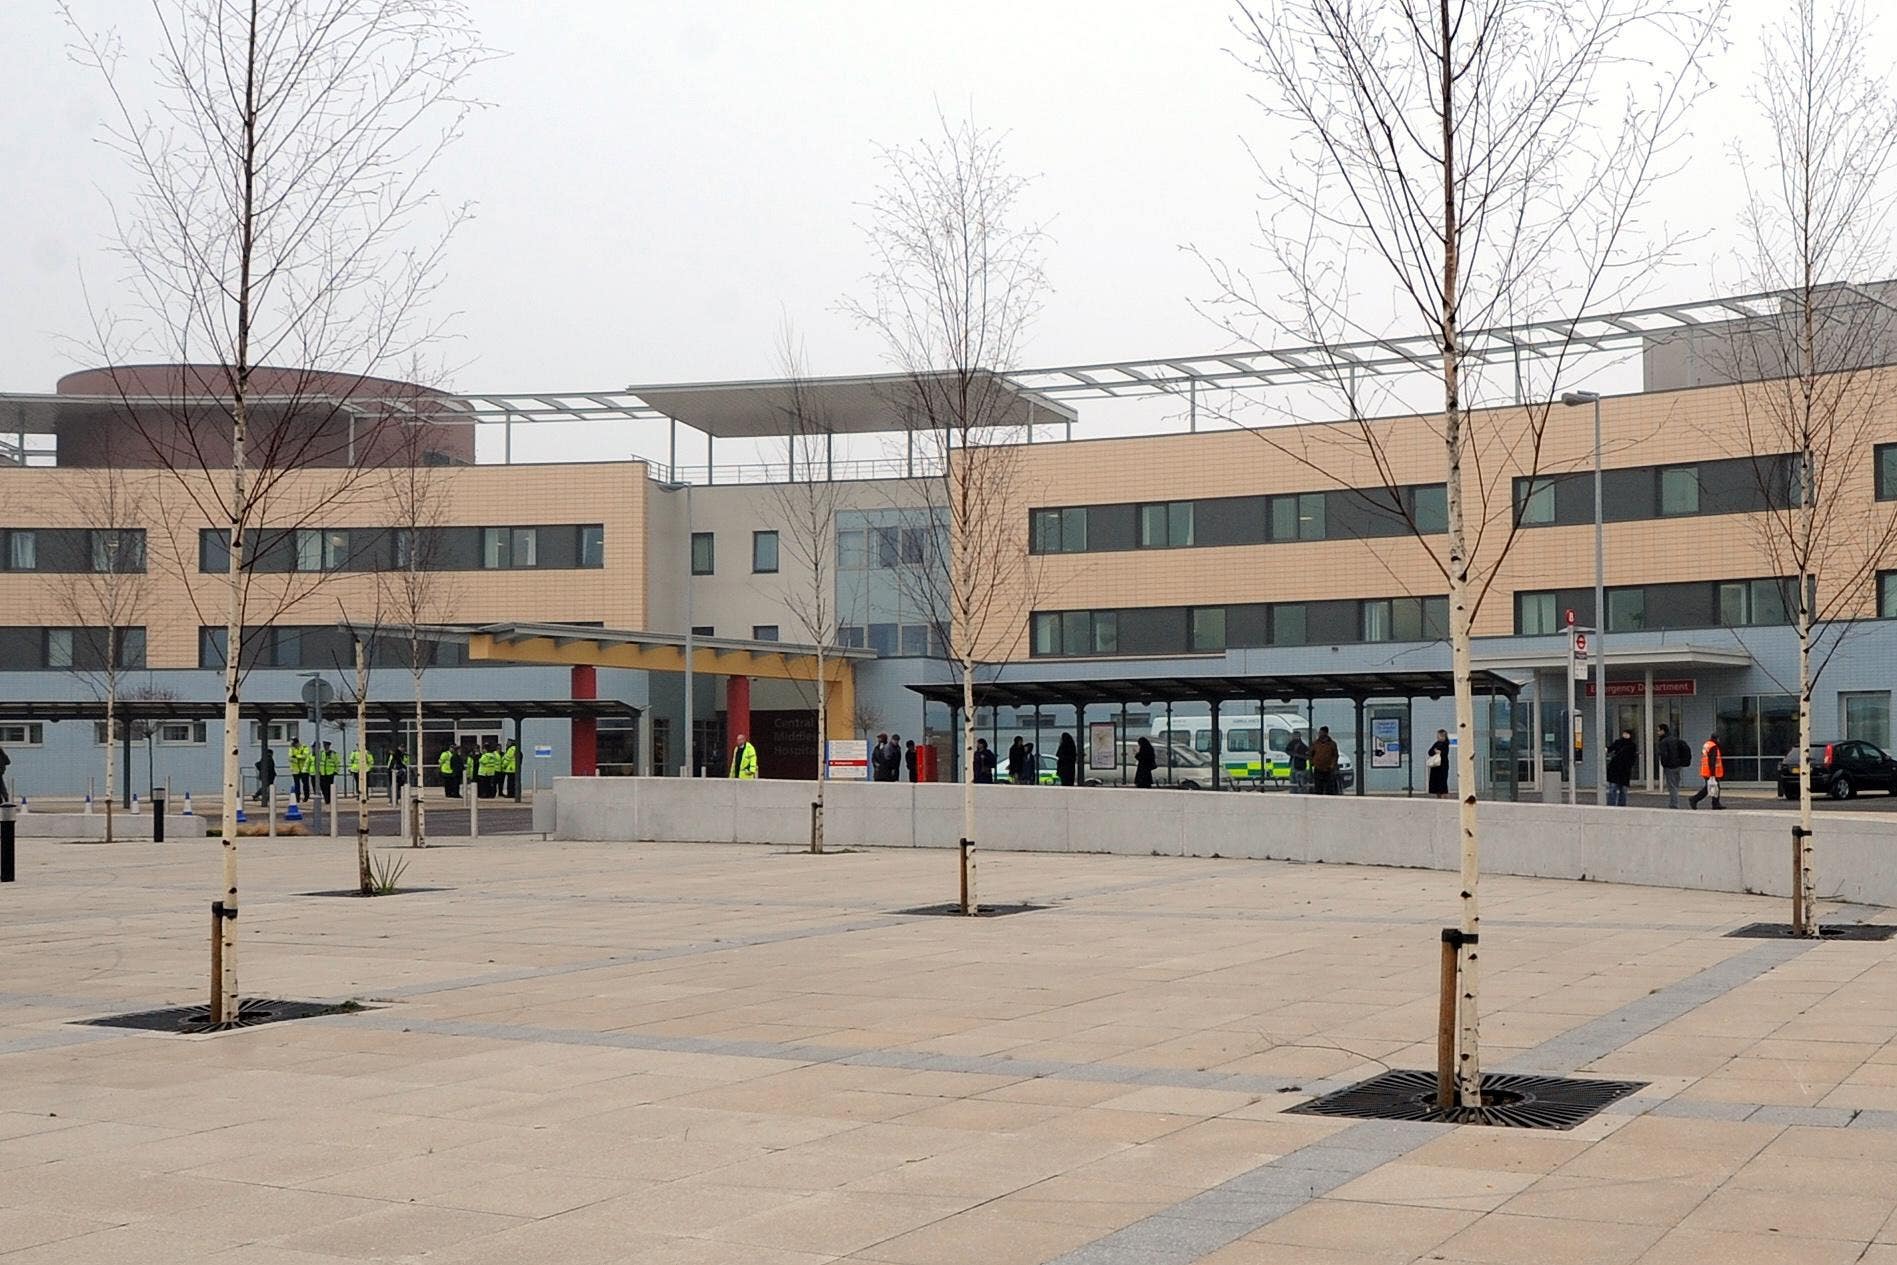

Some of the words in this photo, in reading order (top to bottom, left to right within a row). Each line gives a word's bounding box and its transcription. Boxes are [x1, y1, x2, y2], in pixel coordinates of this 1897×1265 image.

[1637, 682, 1689, 691] Dartment
[775, 717, 814, 728] Central
[775, 746, 817, 757] Hospita
